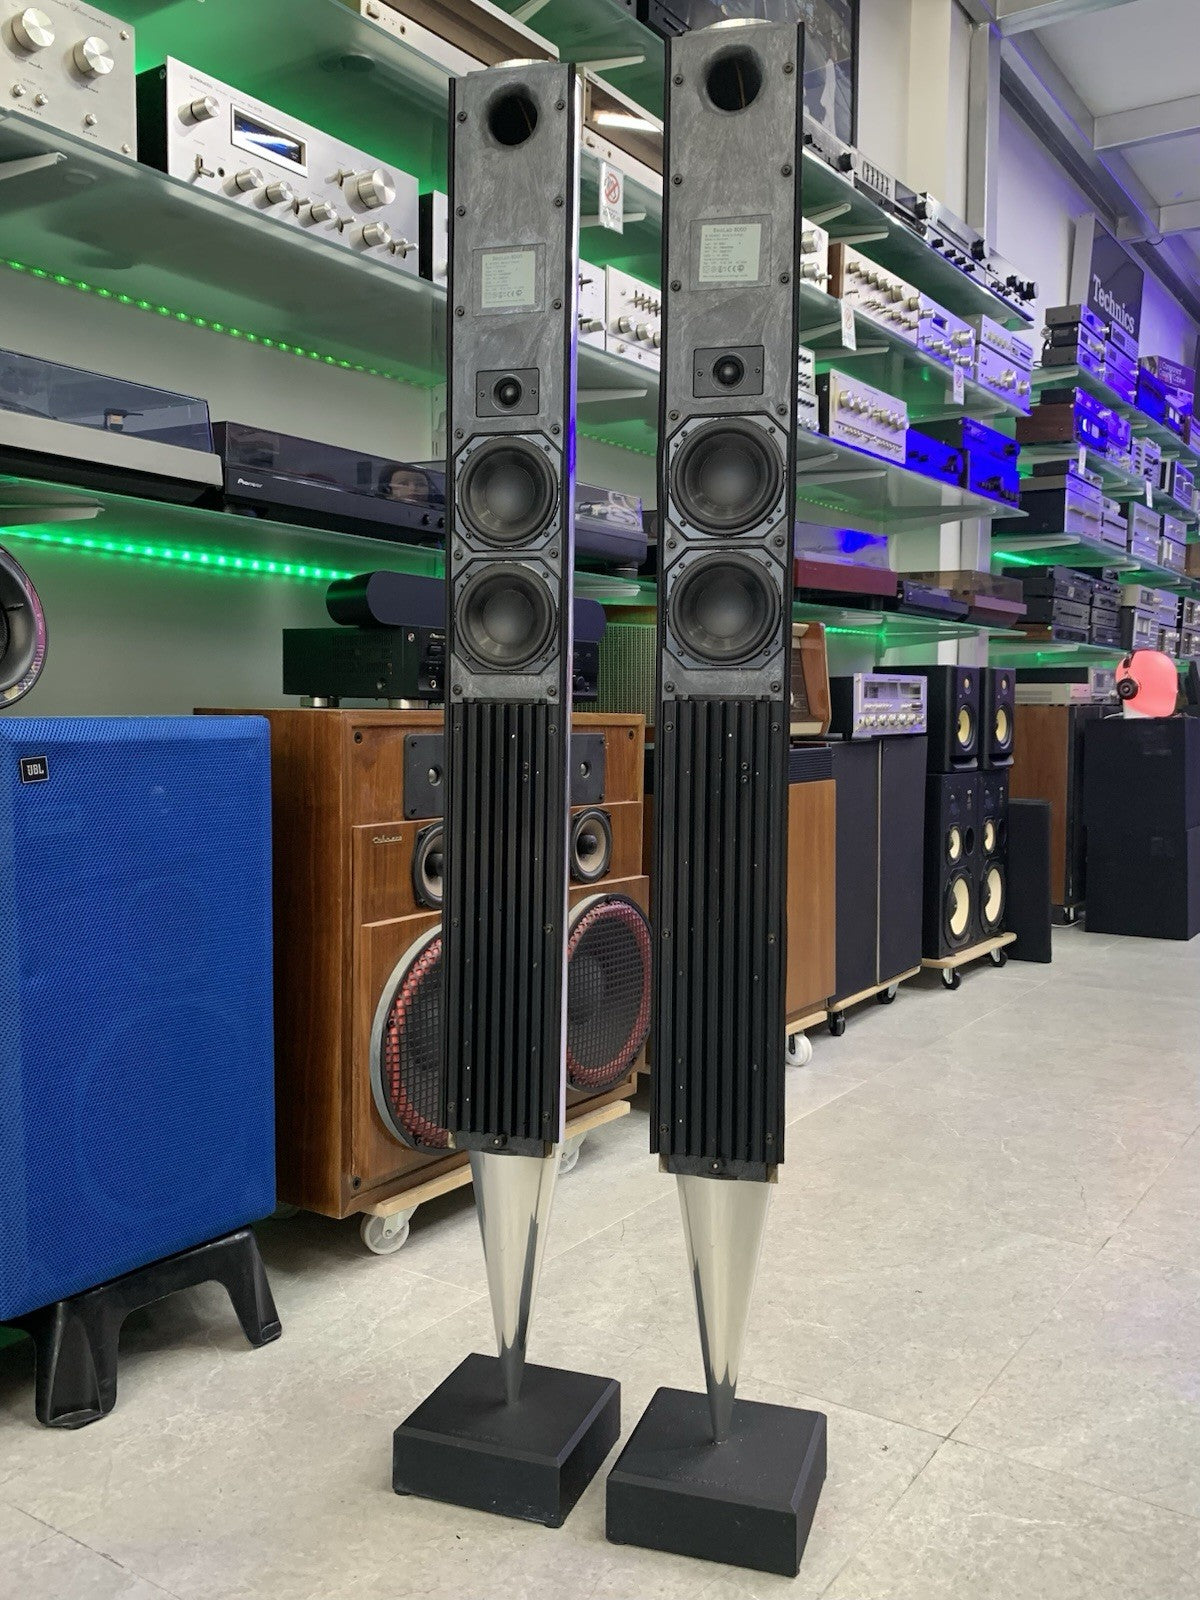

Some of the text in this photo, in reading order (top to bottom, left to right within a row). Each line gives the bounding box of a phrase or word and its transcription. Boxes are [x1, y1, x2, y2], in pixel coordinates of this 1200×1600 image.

[1093, 274, 1135, 334] Technics
[237, 478, 263, 488] Pioneer
[26, 763, 45, 776] JBL
